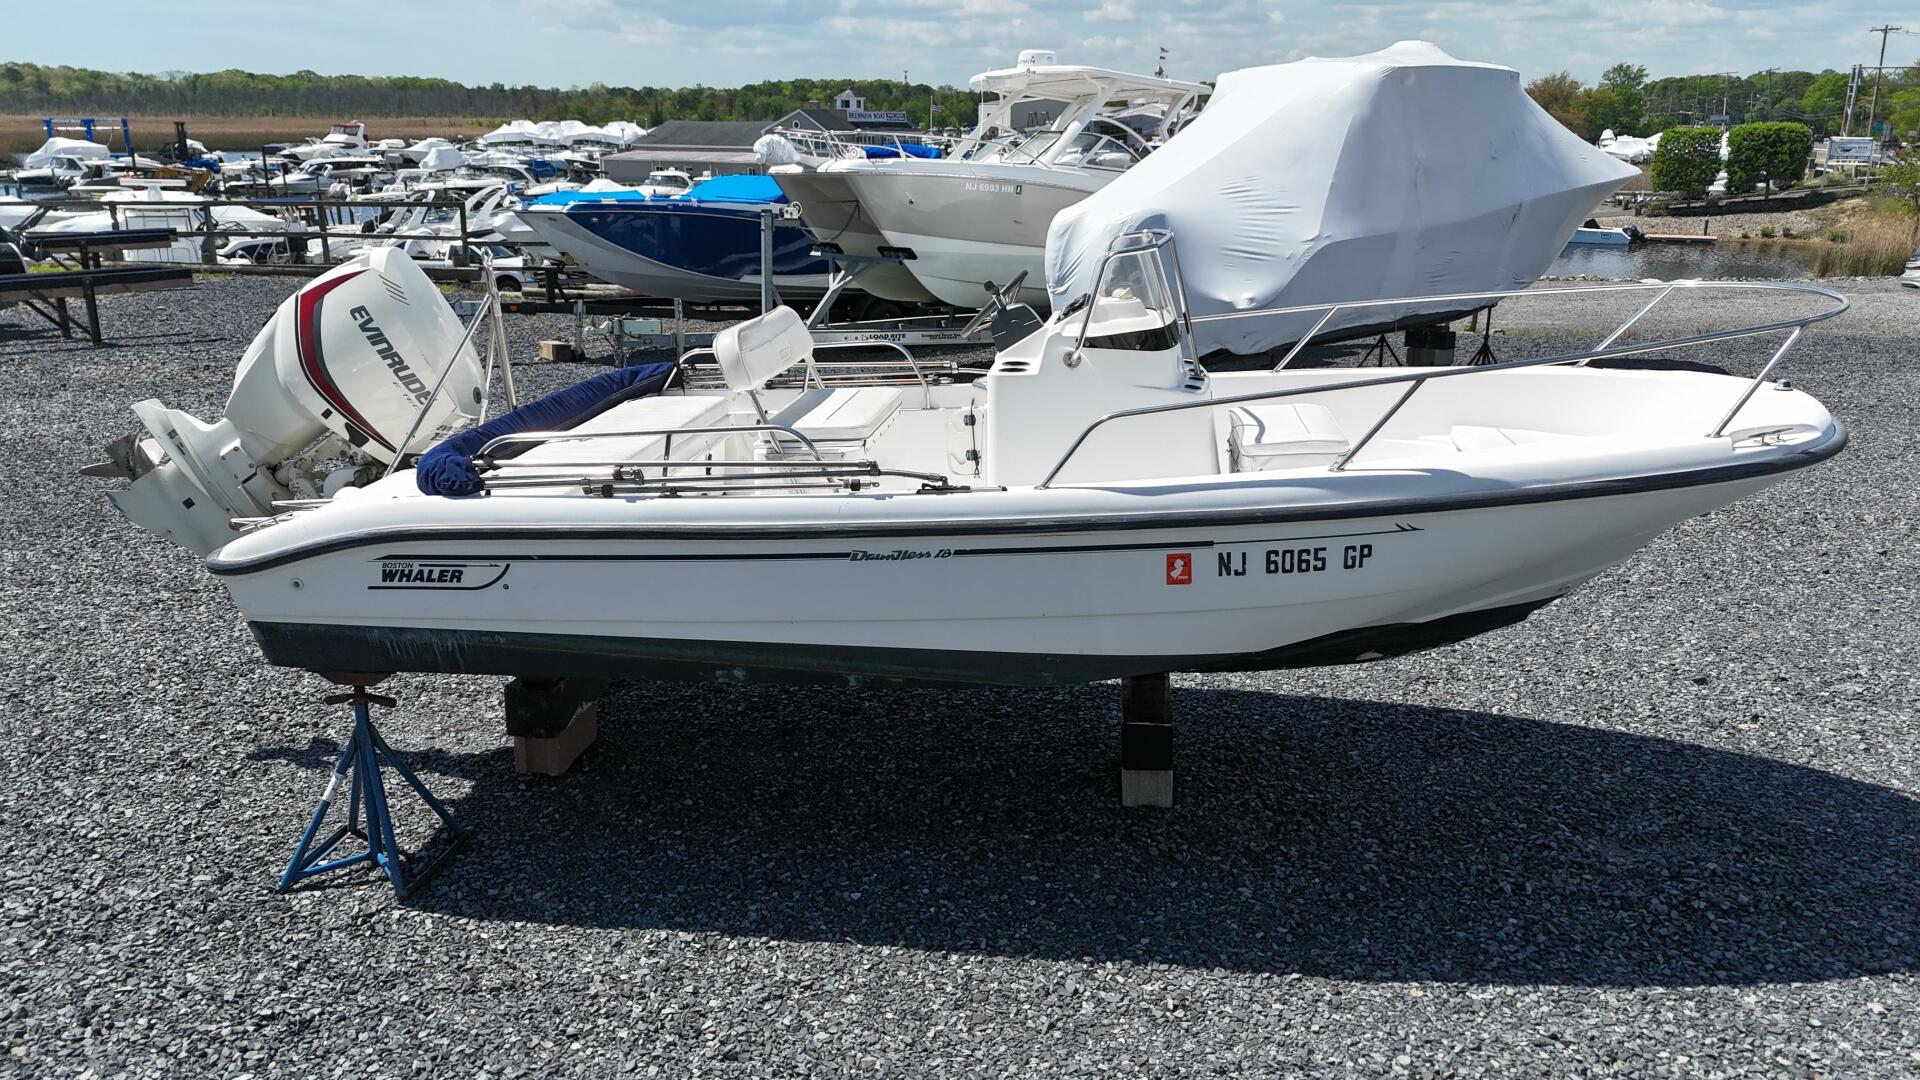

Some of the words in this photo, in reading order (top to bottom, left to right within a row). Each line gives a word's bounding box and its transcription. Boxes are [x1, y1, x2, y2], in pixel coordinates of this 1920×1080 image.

[965, 182, 977, 191] NJ
[979, 183, 1000, 192] 6993
[1001, 184, 1014, 193] HN
[869, 333, 889, 341] LOAD
[349, 304, 432, 406] EVINRUDE
[850, 549, 932, 561] Dauntless
[934, 548, 952, 559] 18
[1218, 551, 1247, 577] NJ
[1265, 546, 1327, 574] 6065
[1343, 544, 1373, 570] GP
[381, 568, 464, 583] WHALER
